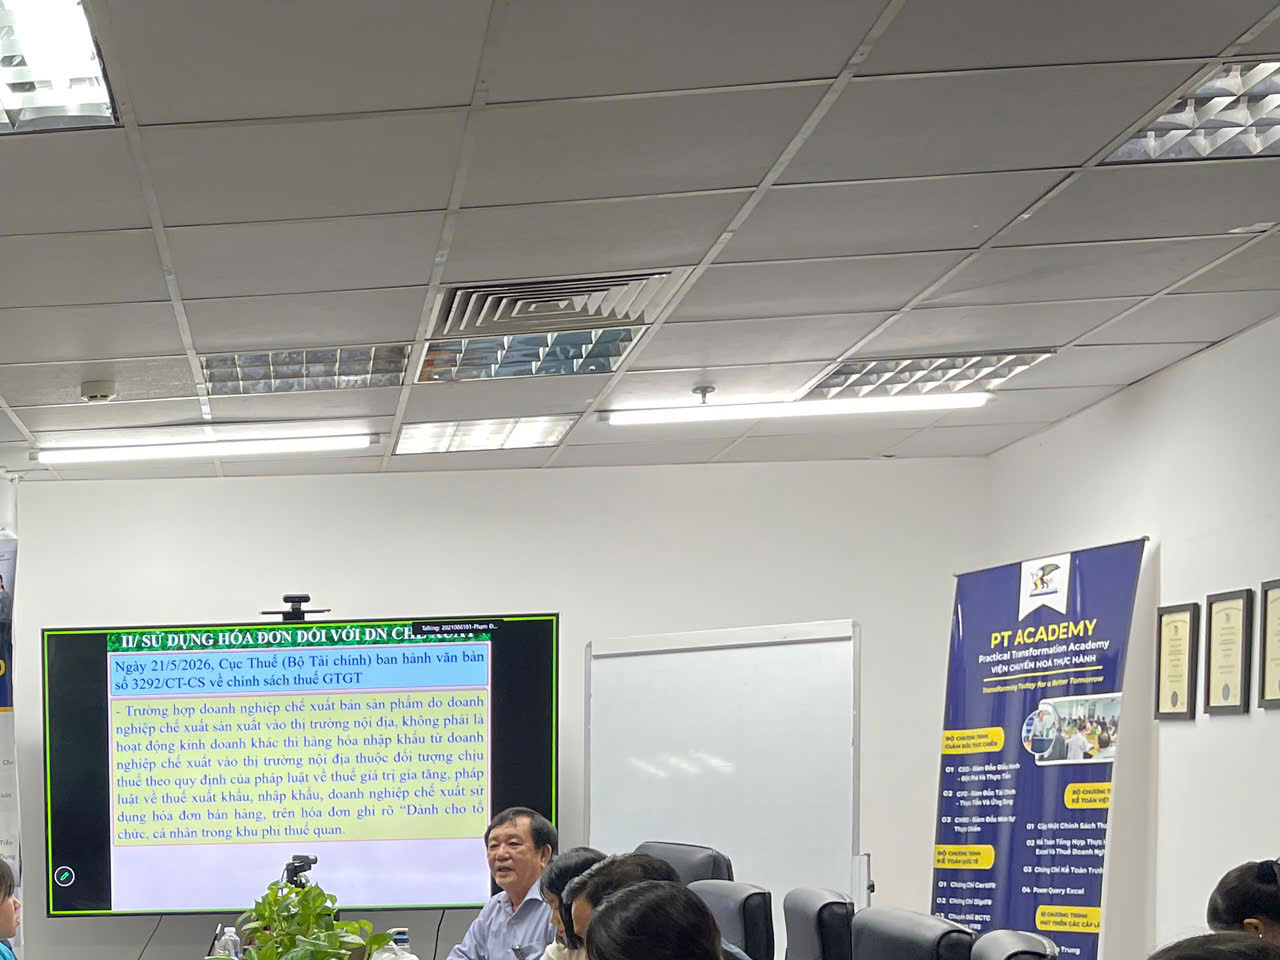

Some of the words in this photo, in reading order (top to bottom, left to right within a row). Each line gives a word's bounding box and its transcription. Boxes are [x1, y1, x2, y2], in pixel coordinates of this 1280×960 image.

[121, 634, 137, 648] II/
[142, 631, 164, 648] SỬ
[167, 632, 214, 650] DỤNG
[218, 629, 254, 645] HÓA
[258, 629, 292, 644] ĐƠN
[297, 626, 326, 642] ĐỐI
[331, 625, 360, 642] VỚI
[364, 627, 388, 641] DN
[991, 631, 1012, 648] PT
[1014, 619, 1097, 646] ACADEMY
[115, 660, 147, 674] Ngày
[151, 658, 215, 673] 21/5/2026,
[219, 658, 243, 671] Cục
[247, 653, 278, 669] Thuế
[282, 655, 305, 670] (Bộ
[310, 655, 329, 667] Tài
[333, 653, 371, 669] chính)
[376, 652, 398, 665] ban
[402, 651, 431, 665] hành
[436, 651, 458, 664] văn
[463, 650, 484, 662] bản
[979, 651, 1010, 663] Practical
[1012, 645, 1067, 659] Transformation
[1068, 640, 1110, 651] Academy
[1072, 654, 1096, 665] HÀNH
[115, 678, 129, 690] số
[132, 676, 206, 690] 3292/CT-CS
[210, 674, 224, 688] về
[227, 674, 260, 687] chính
[263, 673, 289, 687] sách
[293, 671, 319, 685] thuế
[323, 672, 362, 685] GTGT
[126, 704, 168, 719] Trường
[173, 703, 195, 718] hợp
[200, 702, 236, 715] doanh
[240, 701, 280, 717] nghiệp
[285, 698, 305, 712] chế
[310, 697, 335, 711] xuất
[340, 698, 361, 711] bán
[390, 695, 423, 712] phẩm
[427, 697, 443, 709] do
[447, 696, 484, 708] doanh
[116, 721, 155, 737] nghiệp
[160, 718, 179, 733] chế
[184, 717, 208, 732] xuất
[236, 716, 261, 731] xuất
[265, 718, 287, 730] vào
[290, 716, 306, 731] thị
[310, 716, 350, 730] trường
[353, 715, 372, 729] nội
[376, 714, 398, 730] địa,
[402, 713, 440, 728] không
[443, 714, 469, 728] phải
[473, 713, 484, 725] là
[116, 741, 141, 753] hoạt
[145, 739, 175, 753] động
[179, 738, 206, 751] kinh
[210, 738, 247, 750] doanh
[251, 737, 278, 749] khác
[283, 736, 299, 748] thì
[303, 735, 332, 749] hàng
[337, 735, 358, 747] hóa
[363, 734, 392, 748] nhập
[396, 731, 425, 745] khẩu
[430, 733, 443, 744] từ
[447, 731, 484, 743] doanh
[152, 827, 166, 839] cá
[169, 826, 198, 839] nhân
[201, 827, 233, 840] trong
[236, 825, 258, 837] khu
[262, 825, 280, 839] phi
[284, 821, 310, 836] thuế
[313, 824, 345, 838] quan.
